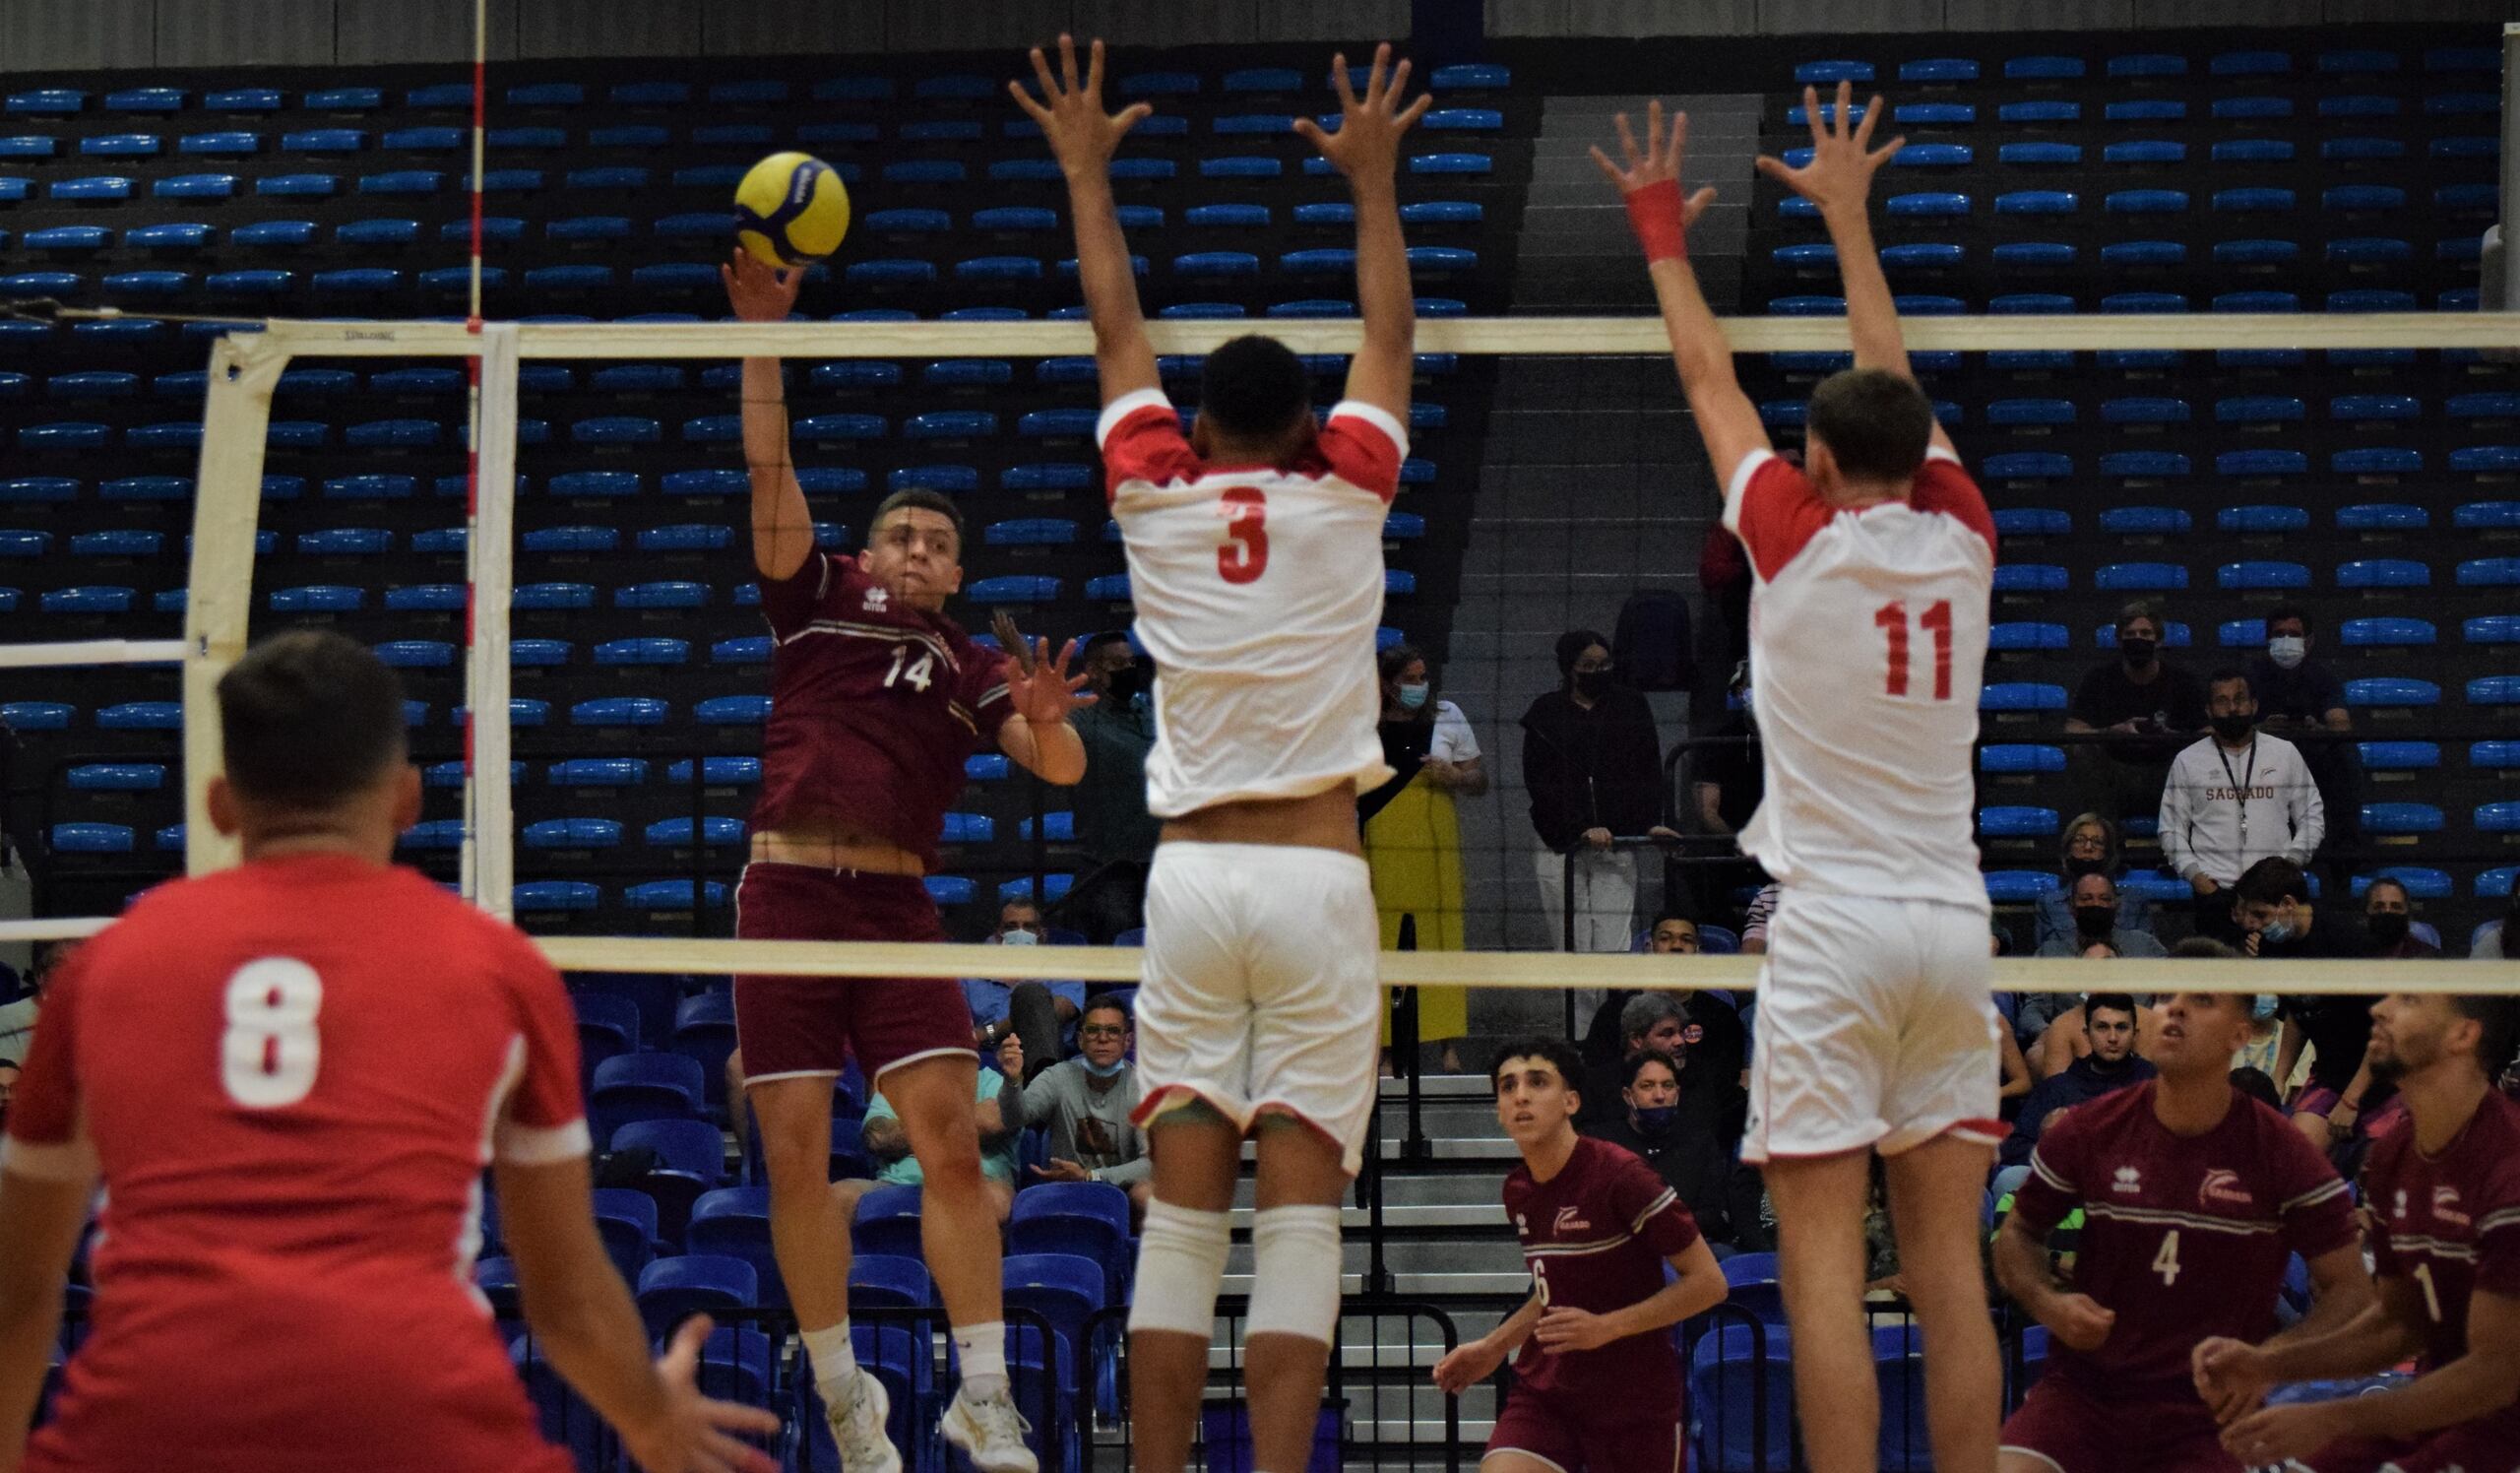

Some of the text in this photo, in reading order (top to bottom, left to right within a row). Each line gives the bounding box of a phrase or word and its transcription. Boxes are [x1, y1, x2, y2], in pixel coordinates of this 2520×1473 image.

[1219, 486, 1269, 584] 3
[884, 645, 933, 692] 14
[1874, 599, 1952, 700] 11
[2206, 787, 2275, 801] SAGRADO
[222, 957, 323, 1108] 8
[1533, 1258, 1549, 1307] 6
[2152, 1230, 2180, 1286] 4
[2413, 1262, 2440, 1321] 1
